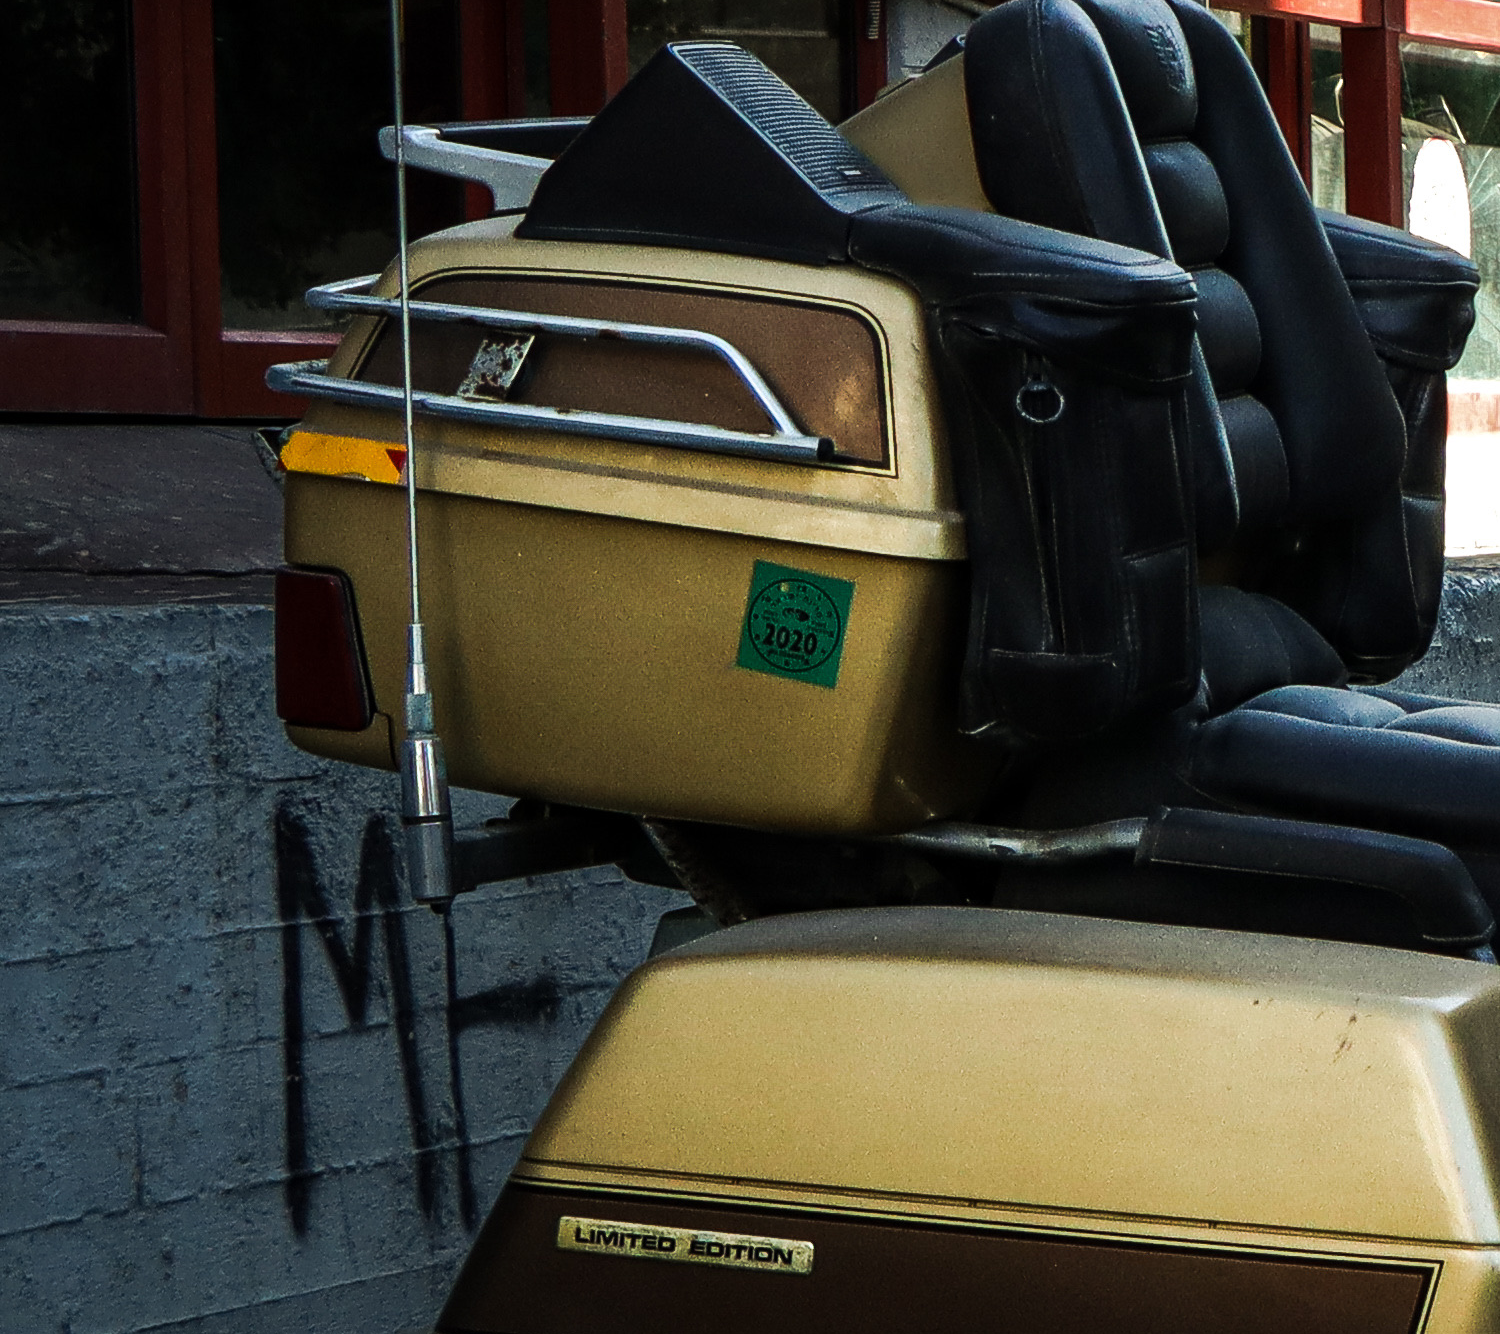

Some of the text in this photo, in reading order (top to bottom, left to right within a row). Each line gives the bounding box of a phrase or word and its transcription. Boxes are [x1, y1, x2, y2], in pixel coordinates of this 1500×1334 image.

[763, 623, 818, 656] 2020
[574, 1227, 793, 1265] LIMITED EDITION
